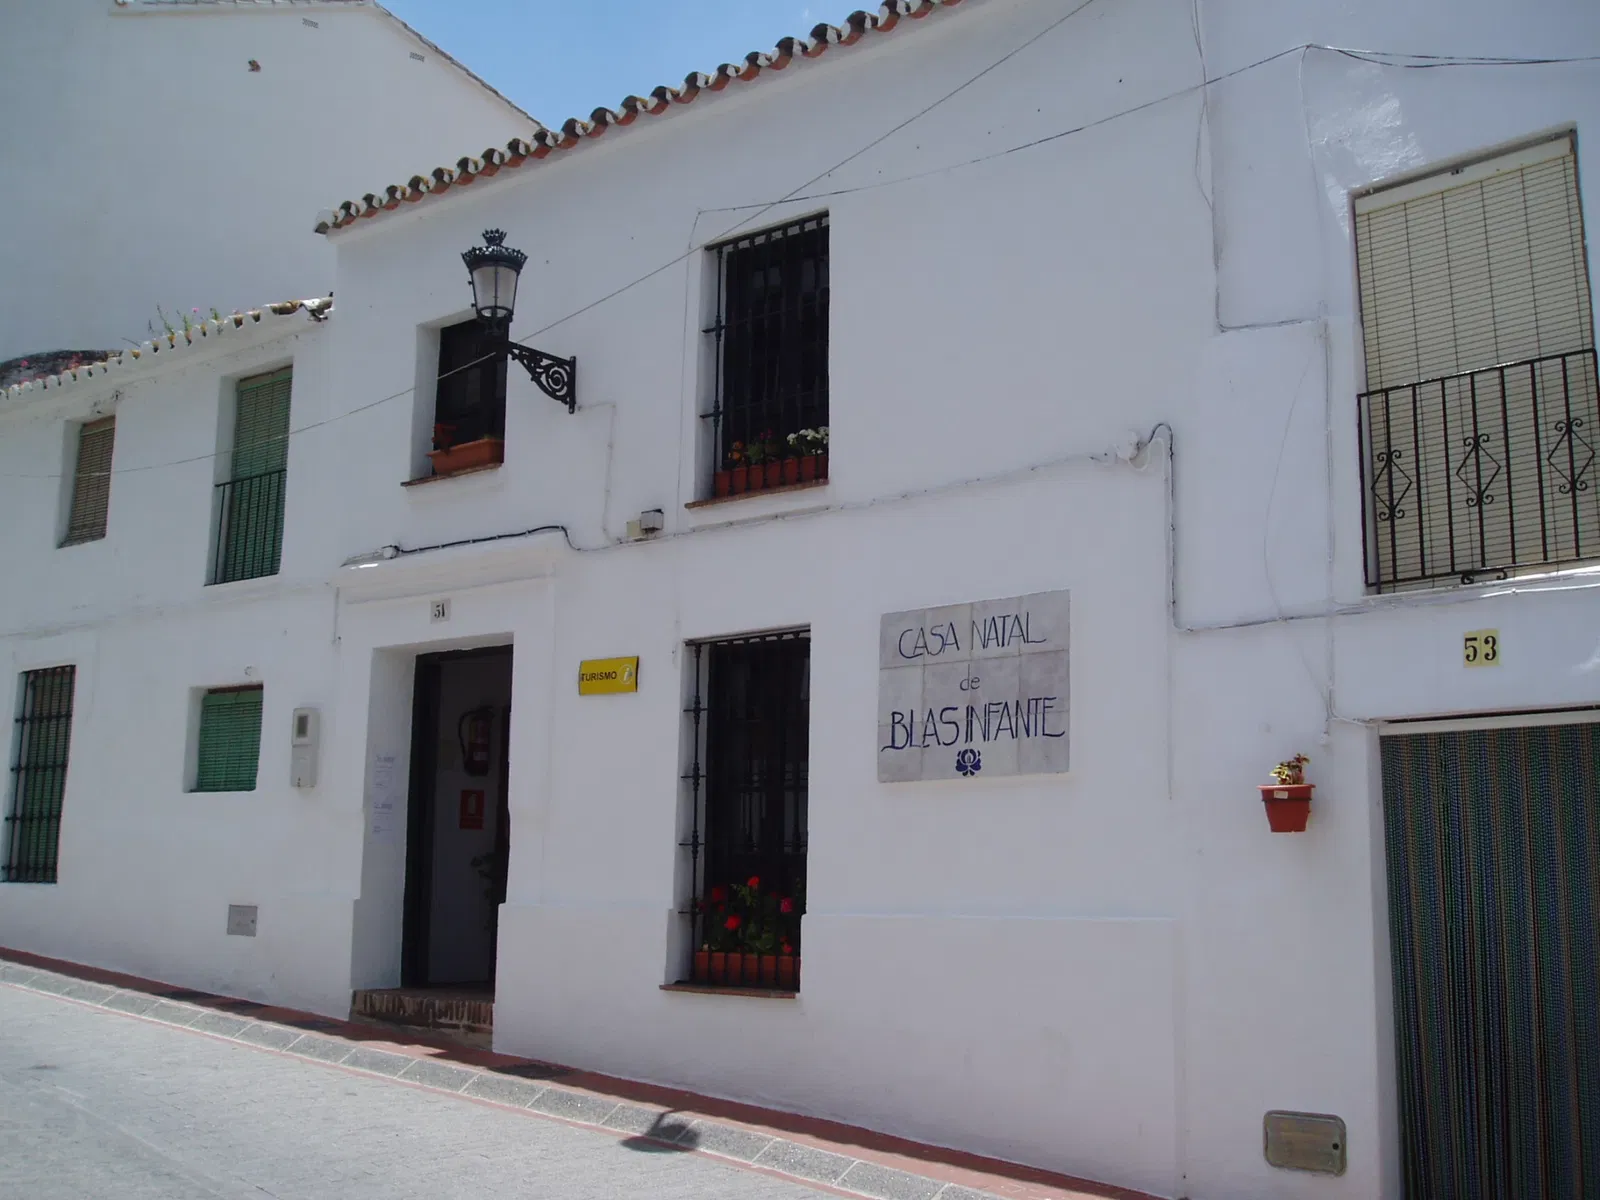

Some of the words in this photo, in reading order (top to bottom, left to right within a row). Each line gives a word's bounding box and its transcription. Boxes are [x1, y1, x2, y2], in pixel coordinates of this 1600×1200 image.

[434, 603, 445, 619] 51
[898, 622, 960, 658] CASA
[971, 612, 1047, 650] NATAL
[1464, 635, 1497, 662] 53
[581, 670, 618, 682] TURISMO
[959, 663, 981, 691] de
[880, 706, 960, 752] BLAS
[964, 697, 1066, 743] INFANTE
